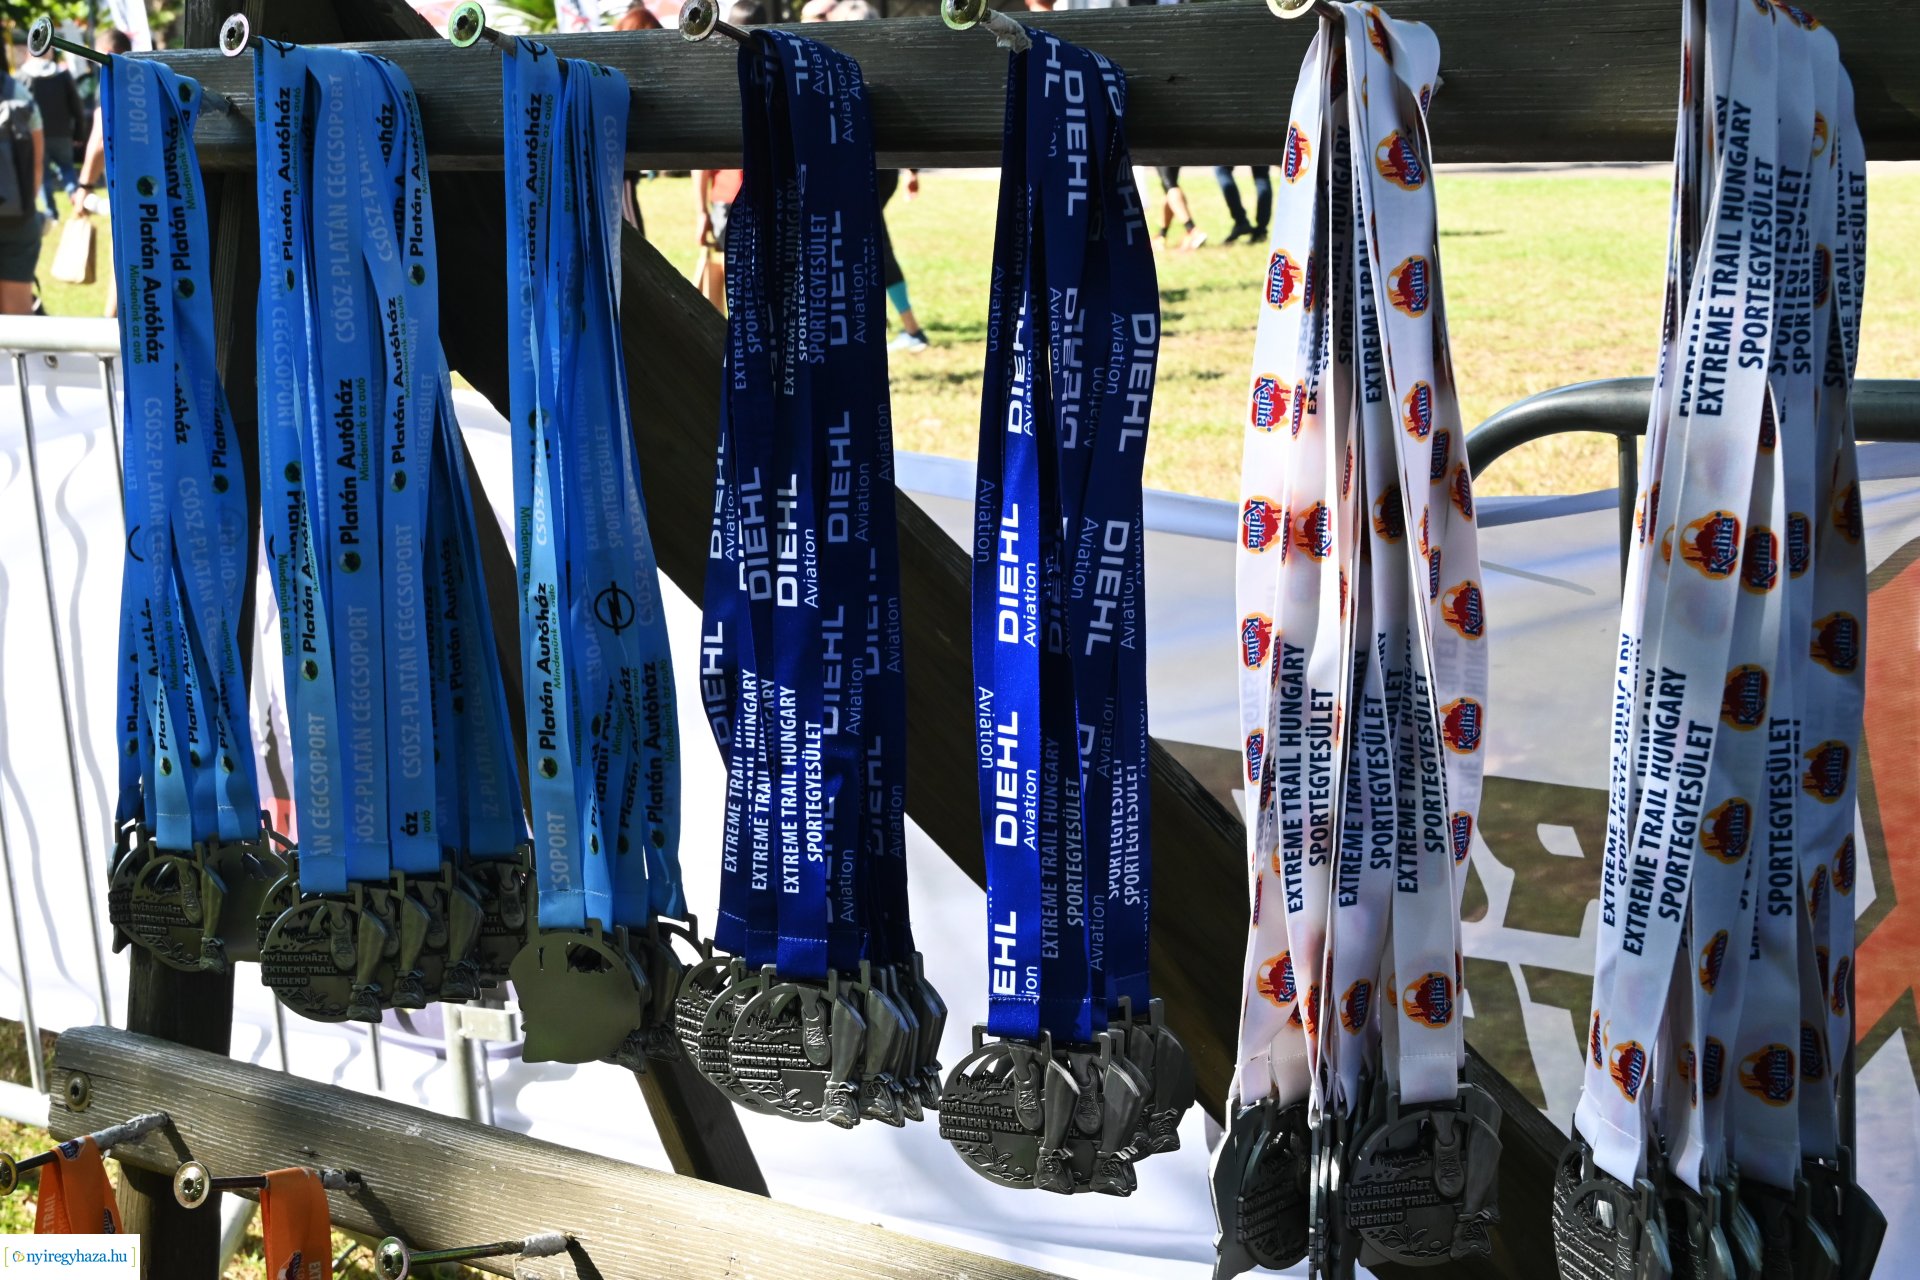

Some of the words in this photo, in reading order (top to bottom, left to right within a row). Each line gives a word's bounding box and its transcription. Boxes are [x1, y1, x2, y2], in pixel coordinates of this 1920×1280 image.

[275, 87, 291, 183] Autóház
[836, 62, 855, 144] Aviation
[1064, 69, 1088, 216] DIEHL
[524, 93, 541, 194] Autóház
[1721, 99, 1752, 222] HUNGARY
[139, 203, 160, 270] Platán
[169, 206, 191, 271] Platán
[283, 190, 294, 261] Platán
[409, 188, 424, 256] Platán
[807, 214, 828, 364] SPORTEGYESÜLET
[830, 210, 848, 346] DIEHL
[1269, 253, 1286, 308] Kalifa
[1409, 258, 1429, 312] Kalifa
[1713, 229, 1742, 297] TRAIL
[1738, 156, 1774, 370] SPORTEGYESÜLET
[143, 275, 165, 364] Autóház
[387, 297, 405, 389] Autóház
[851, 263, 867, 344] Aviation
[989, 265, 1004, 352] Aviation
[1049, 287, 1062, 374] Aviation
[356, 377, 367, 402] autó
[734, 313, 747, 391] EXTREME
[1008, 290, 1027, 434] DIEHL
[1106, 312, 1125, 395] Aviation
[1119, 313, 1156, 452] DIEHL
[1360, 305, 1381, 403] EXTREME
[1696, 305, 1735, 417] EXTREME
[333, 378, 356, 470] Autóház
[358, 405, 368, 417] az
[391, 395, 406, 465] Platán
[1023, 349, 1034, 437] Aviation
[1253, 377, 1275, 429] Kalifa
[1417, 385, 1432, 437] Kalifa
[358, 420, 370, 481] Mindenünk
[827, 411, 851, 543] DIEHL
[338, 476, 360, 544] Platán
[724, 483, 735, 561] Aviation
[740, 466, 773, 601] DIEHL
[776, 474, 798, 607] DIEHL
[854, 462, 870, 542] Aviation
[978, 479, 996, 562] Aviation
[1243, 500, 1265, 550] Kalifa
[802, 527, 819, 609] Aviation
[998, 503, 1019, 644] DIEHL
[1071, 517, 1099, 599] Aviation
[1710, 517, 1738, 575] Kalifa
[1753, 532, 1777, 589] Kalifa
[1788, 518, 1809, 573] Kalifa
[302, 585, 317, 654] Platán
[1023, 562, 1037, 648] Aviation
[1085, 520, 1130, 656] DIEHL
[1120, 570, 1135, 650] Aviation
[1465, 586, 1483, 636] Kalifa
[533, 583, 553, 675] Autóház
[551, 628, 562, 690] Mindenünk
[886, 596, 901, 674] Aviation
[1242, 617, 1260, 668] Kalifa
[1834, 618, 1857, 670] Kalifa
[538, 682, 556, 750] Platán
[643, 662, 661, 751] Autóház
[701, 621, 732, 746] DIEHL
[845, 657, 864, 736] Aviation
[1279, 642, 1305, 747] HUNGARY
[1740, 670, 1764, 725] Kalifa
[780, 685, 797, 769] HUNGARY
[978, 685, 996, 769] Aviation
[1097, 696, 1115, 779] Aviation
[1415, 671, 1445, 854] SPORTEGYESÜLET
[1458, 703, 1480, 751] Kalifa
[1650, 665, 1688, 783] HUNGARY
[644, 757, 664, 823] Platán
[754, 770, 772, 813] TRAIL
[780, 770, 797, 818] TRAIL
[802, 720, 824, 862] SPORTEGYESÜLET
[995, 711, 1019, 847] DIEHL
[1023, 768, 1038, 851] Aviation
[1043, 736, 1059, 825] HUNGARY
[1280, 752, 1302, 803] TRAIL
[1305, 688, 1333, 867] SPORTEGYESÜLET
[1361, 693, 1393, 870] SPORTEGYESÜLET
[1398, 745, 1415, 802] TRAIL
[1824, 745, 1844, 798] Kalifa
[724, 804, 742, 874] EXTREME
[751, 813, 769, 891] EXTREME
[1042, 829, 1058, 879] TRAIL
[1065, 777, 1084, 927] SPORTEGYESÜLET
[1397, 805, 1419, 894] EXTREME
[1638, 789, 1668, 851] TRAIL
[1658, 719, 1714, 923] SPORTEGYESÜLET
[1727, 803, 1746, 857] Kalifa
[1766, 717, 1791, 917] SPORTEGYESÜLET
[780, 821, 800, 894] EXTREME
[840, 849, 855, 922] Aviation
[1282, 803, 1304, 914] EXTREME
[1338, 820, 1364, 908] EXTREME
[1602, 823, 1618, 928] EXTREME
[1042, 881, 1059, 959] EXTREME
[1090, 894, 1105, 971] Aviation
[1622, 851, 1660, 957] EXTREME
[264, 965, 307, 974] EXTREME
[308, 965, 337, 974] TRAIL
[264, 976, 307, 986] WEEKEND
[1430, 976, 1453, 1024] Kalifa
[1627, 1048, 1643, 1098] Kalifa
[1768, 1050, 1794, 1102] Kalifa
[940, 1115, 988, 1129] EXTREME
[989, 1120, 1023, 1132] TRAIL
[940, 1128, 989, 1141] WEEKEND
[1351, 1198, 1402, 1212] EXTREME
[1405, 1194, 1440, 1206] TRAIL
[1351, 1212, 1403, 1226] WEEKEND
